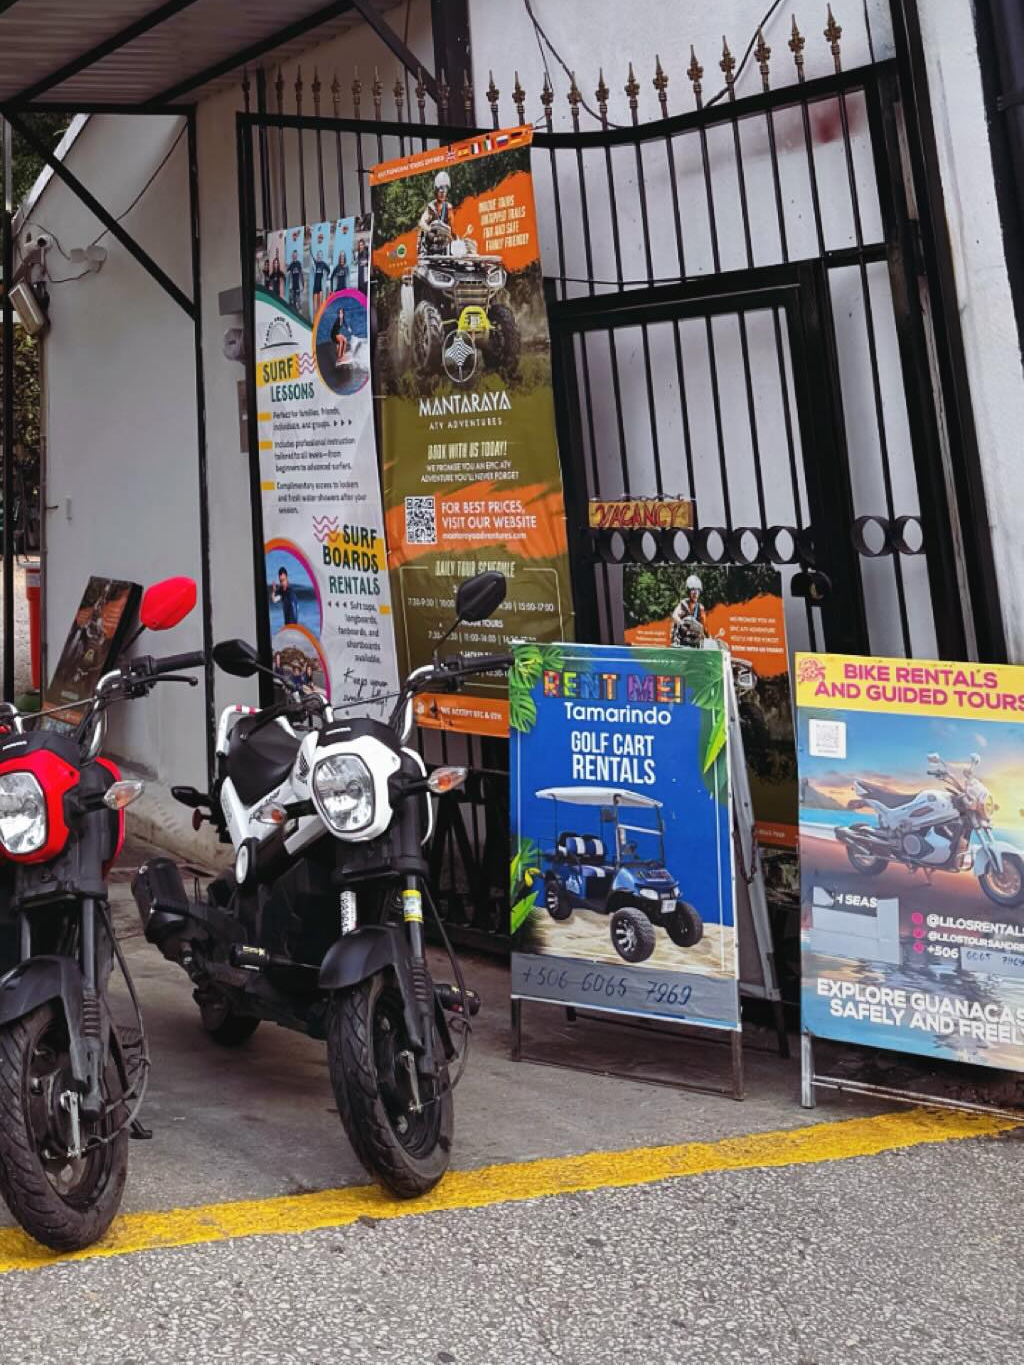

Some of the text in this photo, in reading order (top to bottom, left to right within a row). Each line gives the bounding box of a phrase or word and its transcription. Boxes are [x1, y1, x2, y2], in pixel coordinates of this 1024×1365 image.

[262, 357, 294, 383] SURF
[271, 381, 315, 403] LESSONS
[419, 390, 512, 417] MANTARAYA
[429, 417, 503, 430] ATV ADVENTURES
[296, 438, 326, 449] professional
[427, 440, 507, 460] BOOK WITH US TODAY!
[420, 474, 454, 482] ADVENTURE
[475, 473, 494, 481] NEVER
[495, 471, 519, 480] FORGET
[427, 460, 512, 472] WE PROMISE YOU AN EPIC ATV
[318, 493, 339, 502] showers
[341, 492, 353, 501] after
[355, 494, 367, 503] your
[441, 500, 525, 514] FOR BEST PRICES,
[442, 515, 536, 529] VISIT OUR WEBSITE
[595, 503, 682, 526] VACANCY
[343, 523, 378, 549] SURF
[322, 544, 379, 574] BOARDS
[436, 560, 455, 576] DAILY
[457, 560, 476, 577] TOUR
[329, 575, 381, 595] RENTALS
[481, 619, 504, 628] TOURS
[543, 670, 683, 704] RENT ME!
[843, 663, 890, 682] BIKE
[895, 667, 998, 689] RENTALS
[815, 681, 861, 699] AND
[865, 684, 948, 706] GUIDED
[452, 707, 473, 717] ACCEPT
[564, 702, 672, 726] Tamarindo
[571, 731, 655, 756] GOLF CART
[572, 754, 657, 785] RENTALS
[845, 894, 878, 908] SEAS
[927, 945, 959, 959] +506
[522, 967, 692, 1005] +506 6065 7969
[817, 977, 907, 1008] EXPLORE
[830, 999, 905, 1026] SAFELY
[909, 1012, 954, 1034] AND
